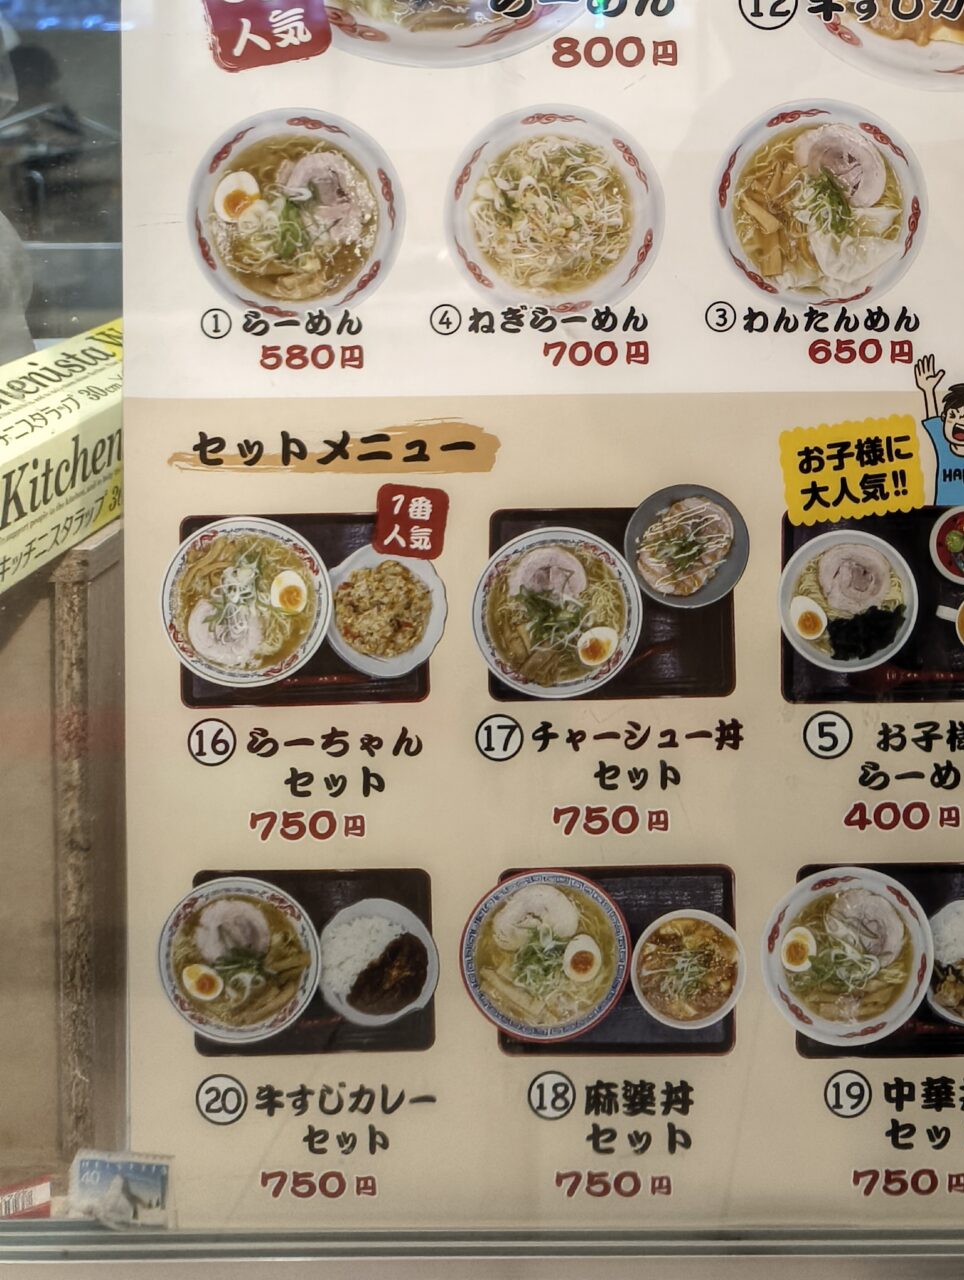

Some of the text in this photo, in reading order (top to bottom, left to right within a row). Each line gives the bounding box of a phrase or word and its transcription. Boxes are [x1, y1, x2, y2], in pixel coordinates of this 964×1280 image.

[232, 8, 313, 57] 人気
[551, 35, 679, 69] 800円
[242, 309, 363, 337] らーめん
[467, 304, 650, 335] ねぎらーめん
[742, 304, 921, 334] わんたんめん
[259, 344, 364, 370] 580円
[542, 340, 649, 367] 700円
[808, 338, 914, 365] 650円
[193, 430, 477, 466] セットメニュー
[797, 434, 914, 475] お子様に
[391, 493, 434, 522] 1番
[383, 524, 433, 551] 人気
[246, 726, 424, 758] らーちゃん
[532, 719, 744, 753] チャーシュー丼
[285, 765, 386, 798] セット
[594, 758, 682, 791] セット
[248, 810, 367, 841] 750円
[551, 804, 670, 836] 750円
[842, 801, 961, 831] 400円
[254, 1081, 437, 1118] 牛すじカレー
[584, 1080, 695, 1117] 麻婆丼
[303, 1124, 390, 1155] セット
[586, 1122, 692, 1154] セット
[260, 1170, 377, 1199] 750円
[554, 1170, 672, 1198] 750円
